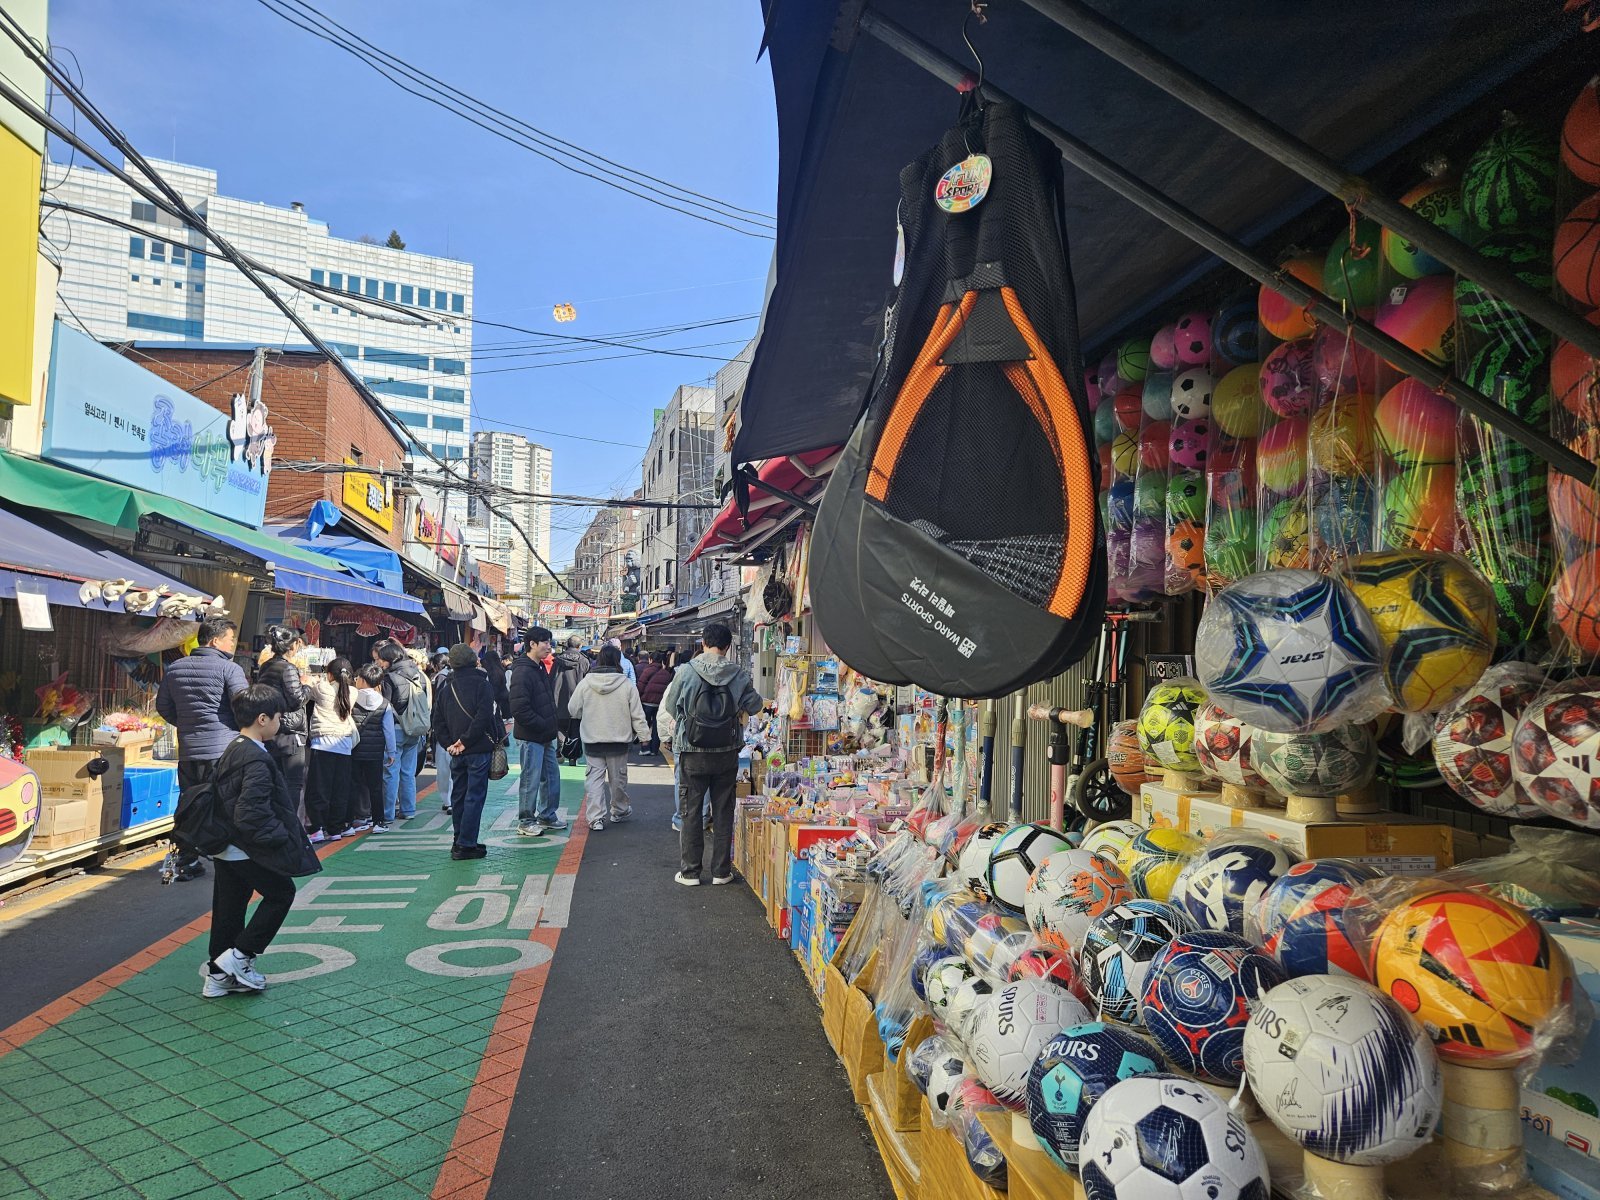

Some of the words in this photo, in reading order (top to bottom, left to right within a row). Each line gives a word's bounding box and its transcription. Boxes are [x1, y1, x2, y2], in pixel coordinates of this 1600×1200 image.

[84, 402, 107, 423] 열쇠고리
[114, 416, 125, 431] 팬시
[131, 424, 146, 442] 판촉물
[909, 576, 930, 598] 라켓
[541, 604, 556, 613] LEGO
[559, 605, 574, 613] LEGO
[901, 592, 935, 624] SPORTS
[928, 591, 956, 618] 패밀리
[934, 620, 961, 646] WARO
[1189, 969, 1210, 989] PARIS
[998, 985, 1019, 1037] SPURS
[1038, 1039, 1101, 1062] SPURS
